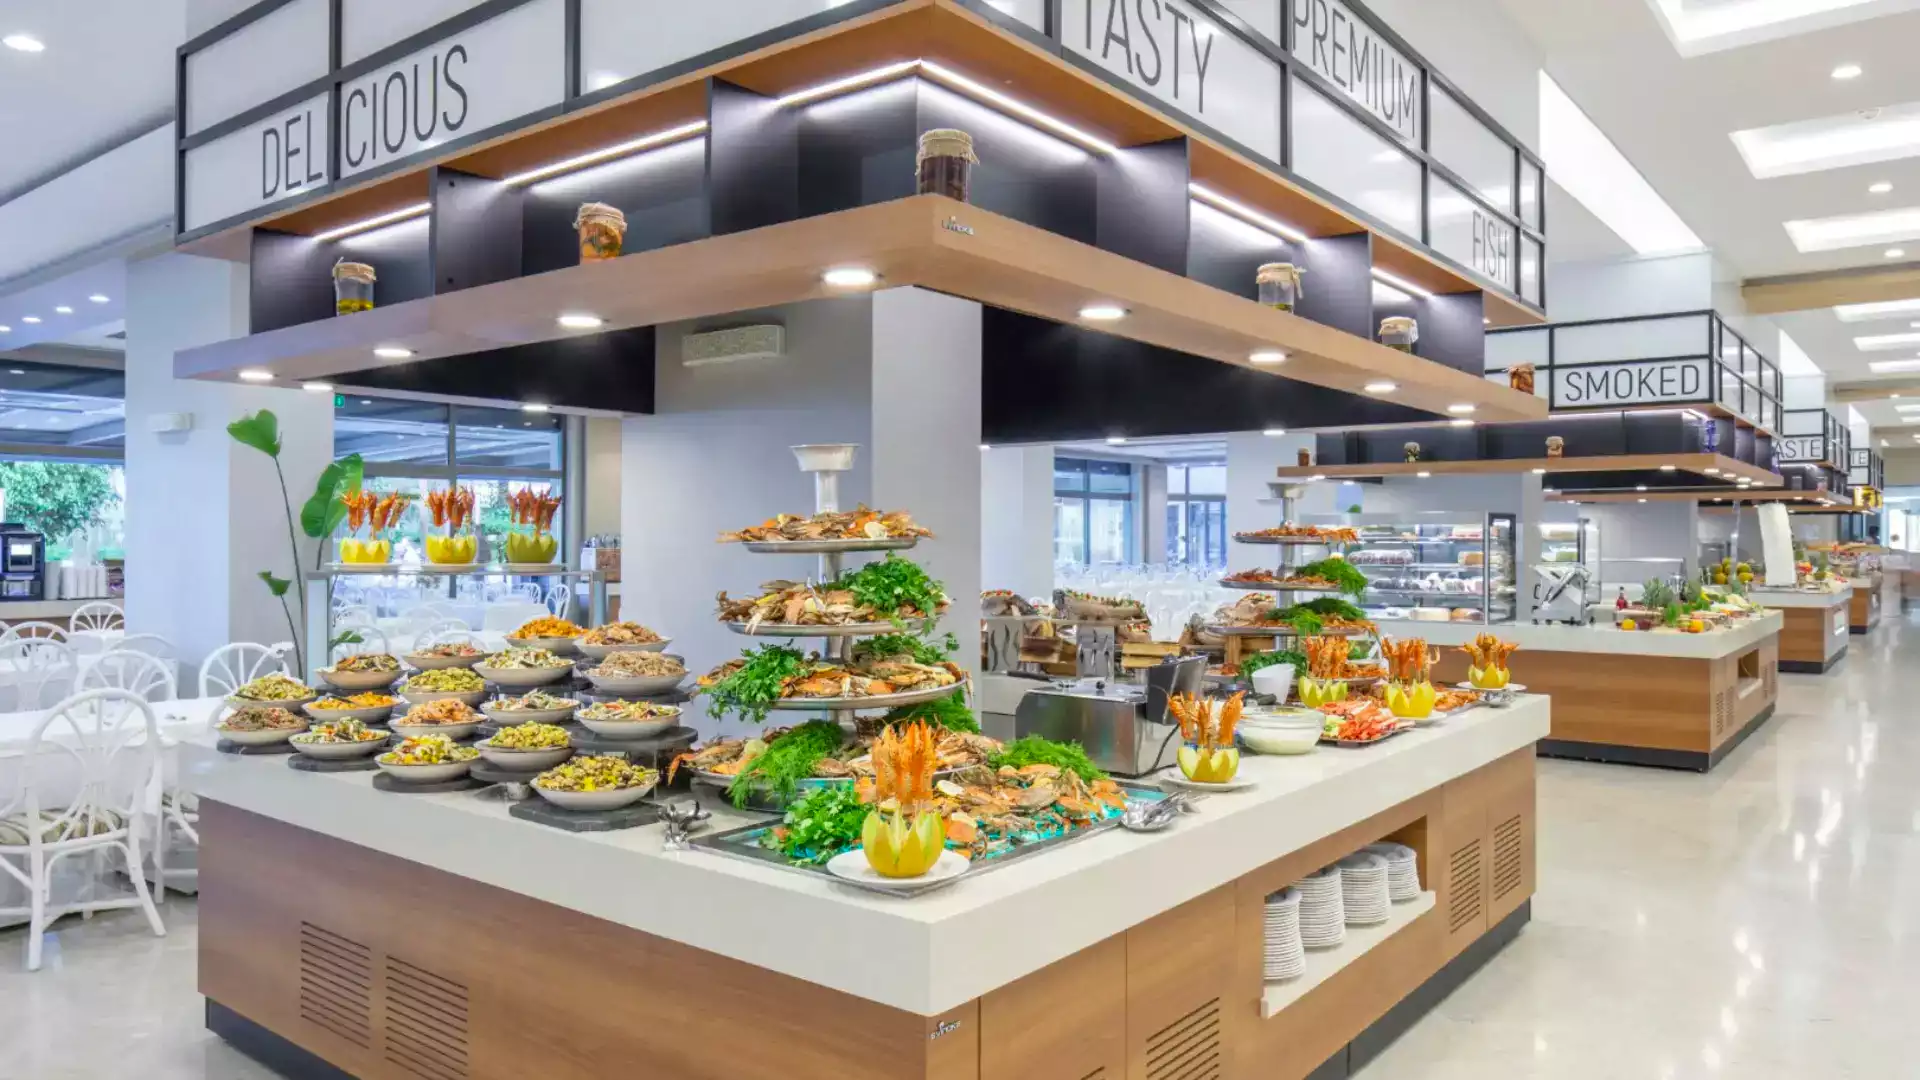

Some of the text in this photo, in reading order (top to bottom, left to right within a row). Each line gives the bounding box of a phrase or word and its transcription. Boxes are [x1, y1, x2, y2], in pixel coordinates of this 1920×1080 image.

[262, 44, 468, 200] DELCIOUS
[1293, 0, 1414, 138] PREMIUM
[1473, 209, 1507, 284] FISH
[1565, 364, 1700, 401] SMOKED
